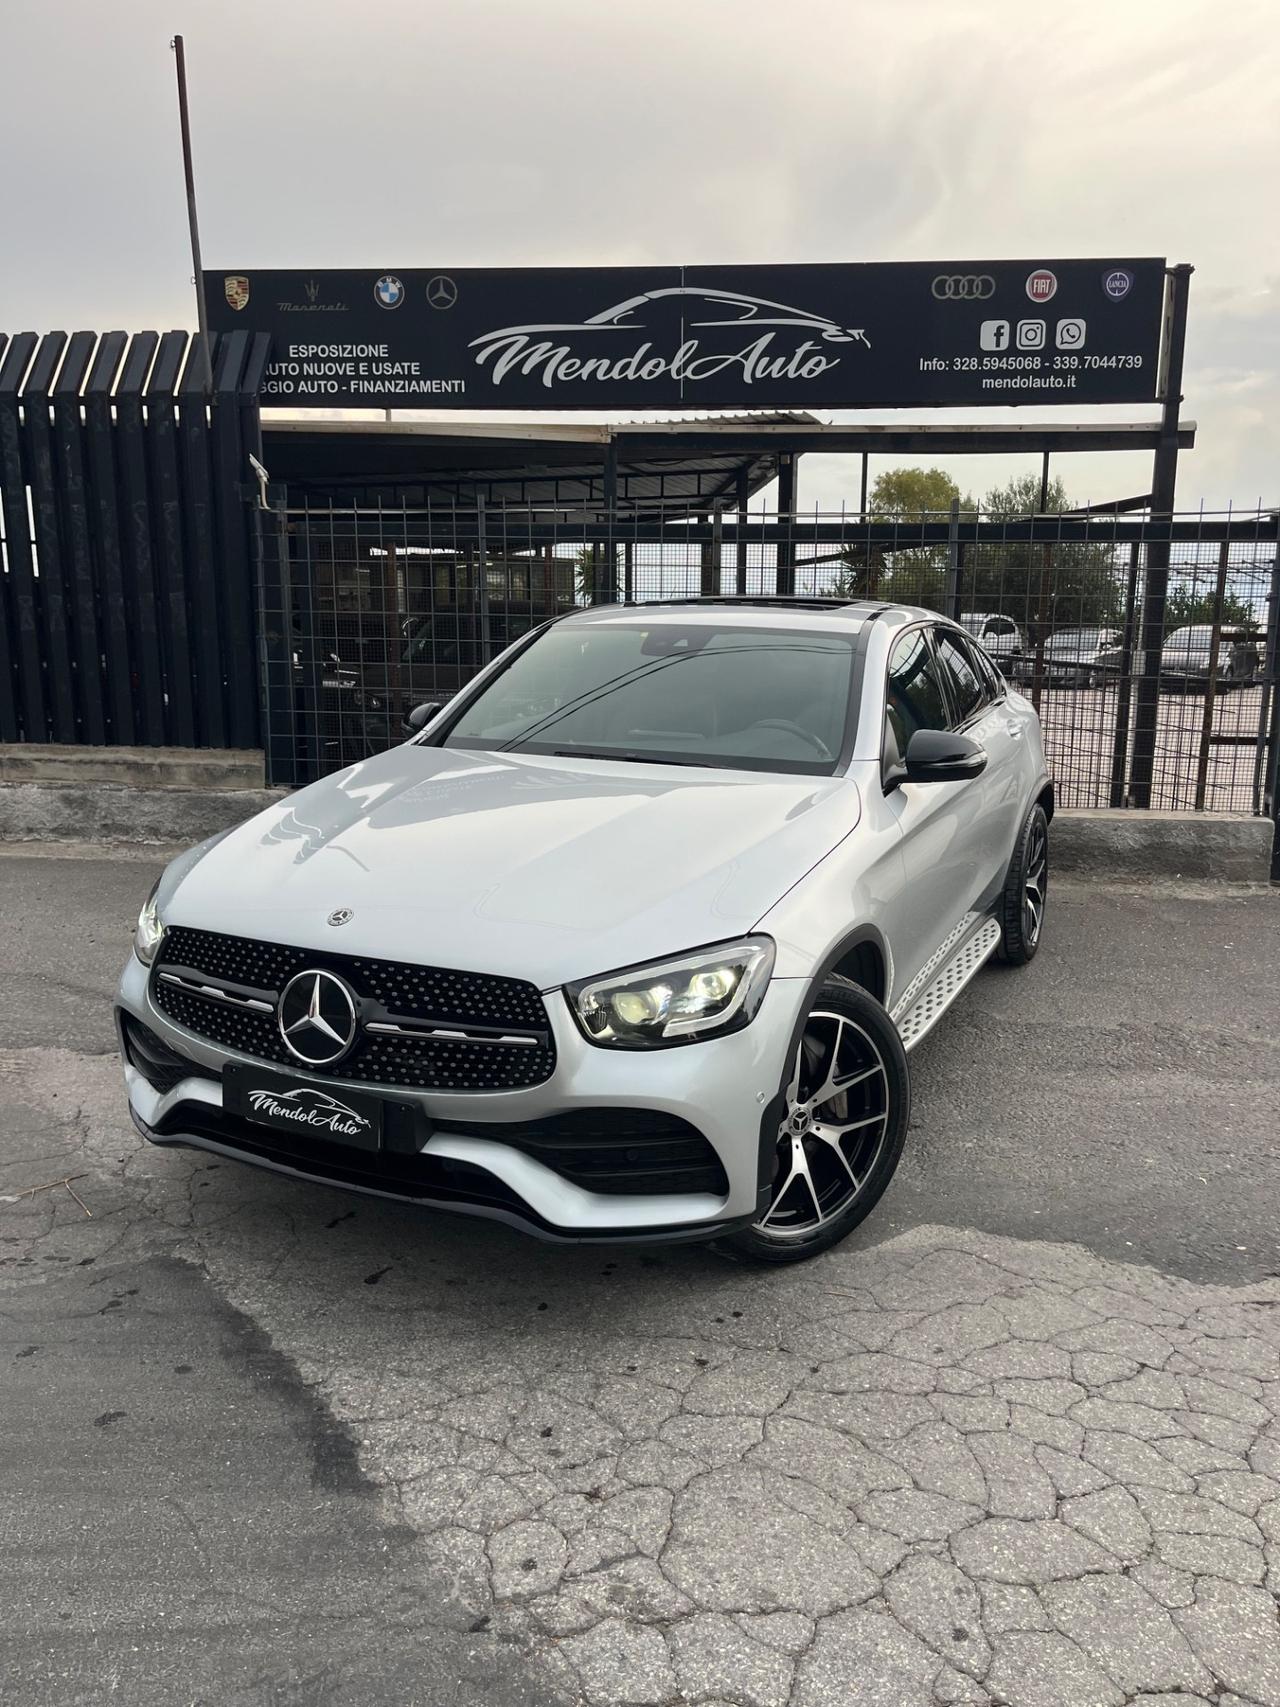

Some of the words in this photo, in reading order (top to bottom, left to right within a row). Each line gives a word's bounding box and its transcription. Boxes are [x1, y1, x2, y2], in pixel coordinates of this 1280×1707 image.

[376, 276, 402, 288] BMW
[1033, 279, 1051, 294] FIAT
[288, 344, 389, 358] ESPOSIZIONE
[303, 362, 355, 375] NUOVE
[359, 362, 368, 375] E
[372, 362, 420, 375] USATE
[919, 357, 950, 371] Info:
[953, 357, 1041, 371] 328.5945068
[1052, 355, 1143, 370] 339.7044739
[298, 380, 339, 393] AUTO
[350, 379, 466, 393] FINANZIAMENTI
[982, 375, 1077, 389] mendolauto.it
